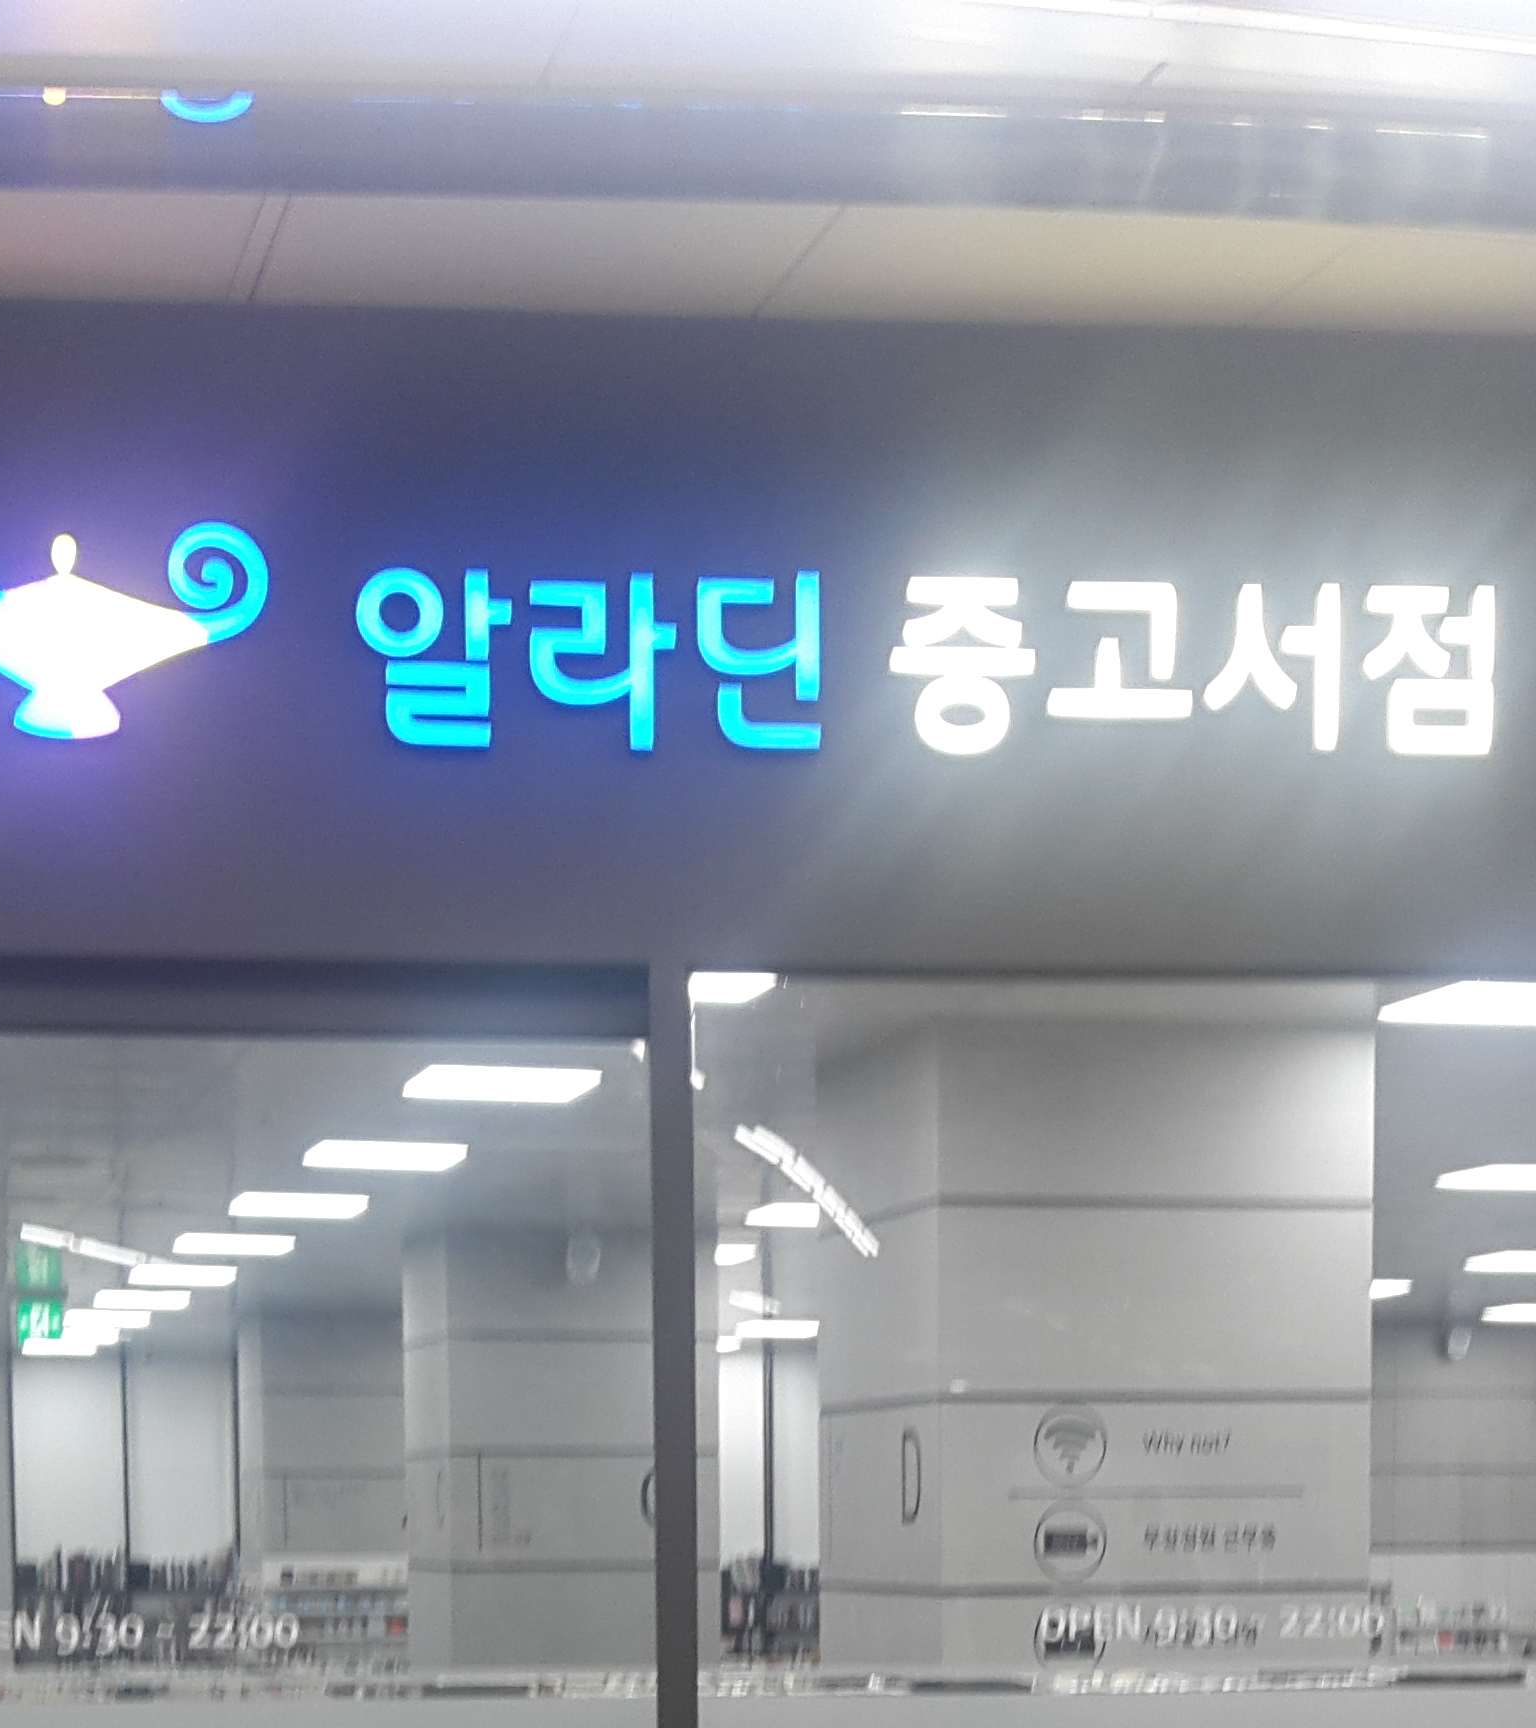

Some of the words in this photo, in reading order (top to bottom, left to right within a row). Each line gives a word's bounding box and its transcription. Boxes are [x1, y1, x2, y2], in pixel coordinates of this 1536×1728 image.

[355, 566, 823, 751] 알라딘
[887, 574, 1498, 757] 중고서점
[1037, 1603, 1141, 1641] OPEN
